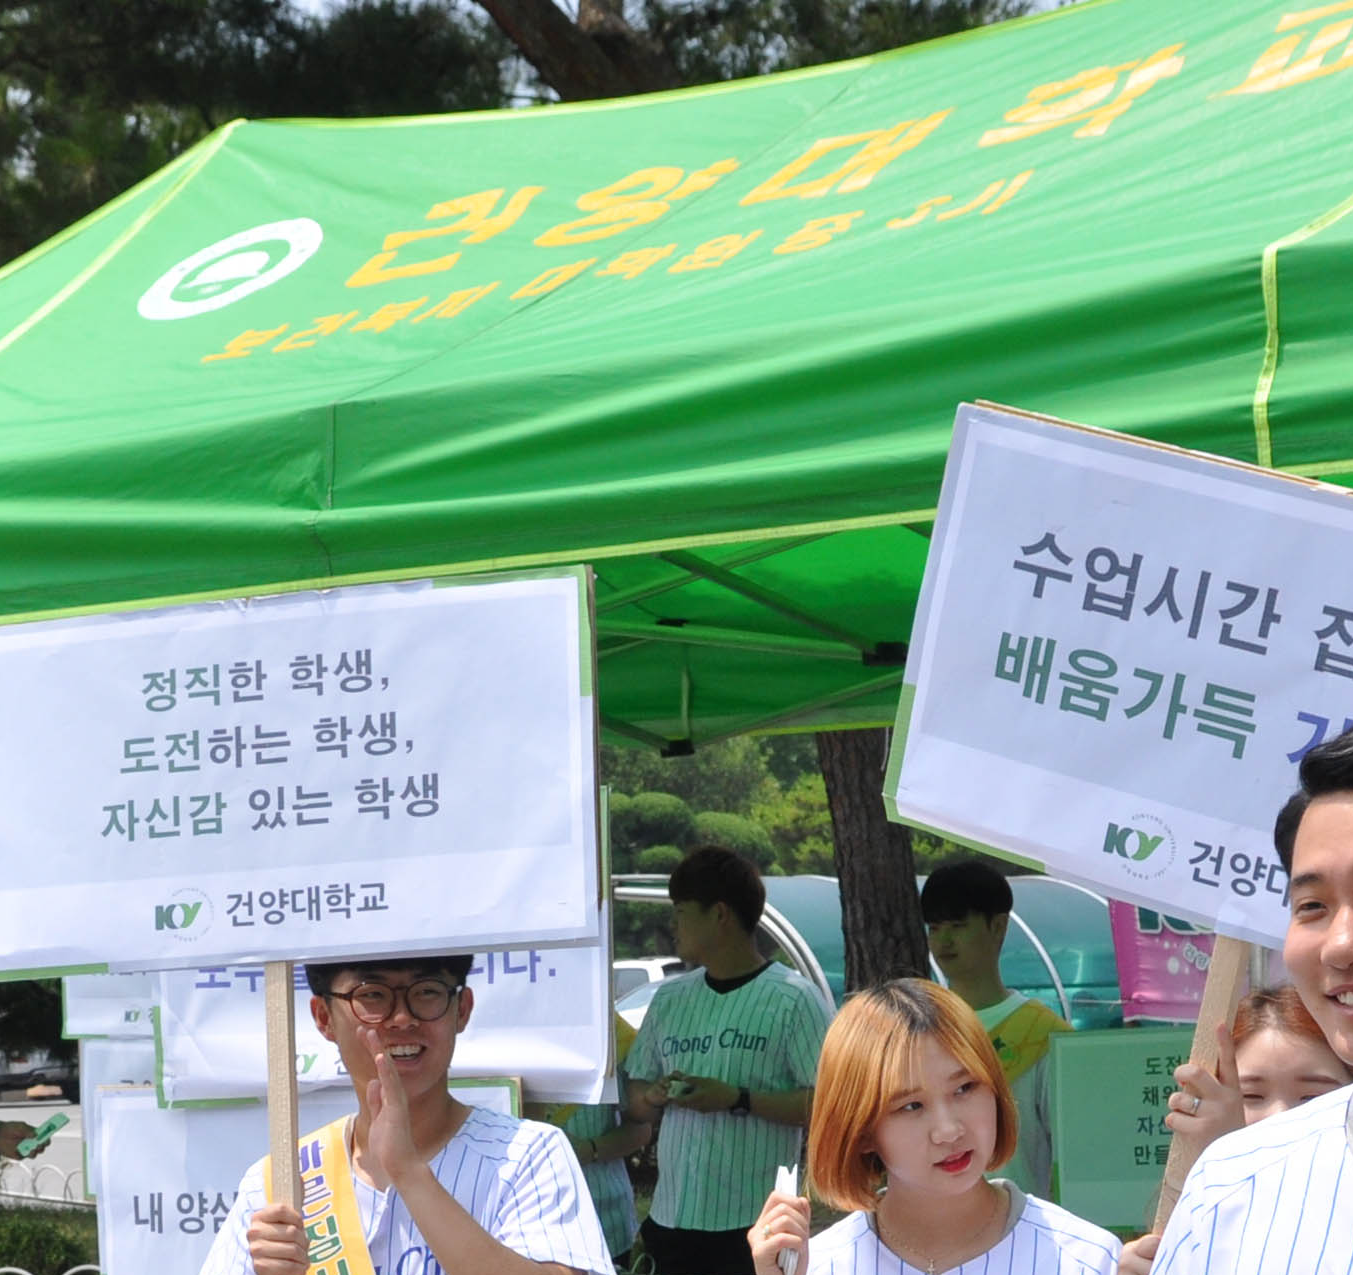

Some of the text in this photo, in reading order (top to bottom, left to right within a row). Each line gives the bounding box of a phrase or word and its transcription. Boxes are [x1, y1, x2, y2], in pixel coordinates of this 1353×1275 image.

[1012, 531, 1283, 656] 수업시간
[142, 648, 390, 713] 정직한 학생,
[994, 630, 1258, 760] 배움가득
[119, 711, 415, 776] 도전하는 학생,
[101, 771, 442, 843] 자신감 있는 학생
[226, 882, 389, 929] 건양대학교
[662, 1028, 767, 1058] Chong Chun
[133, 1192, 163, 1234] 내
